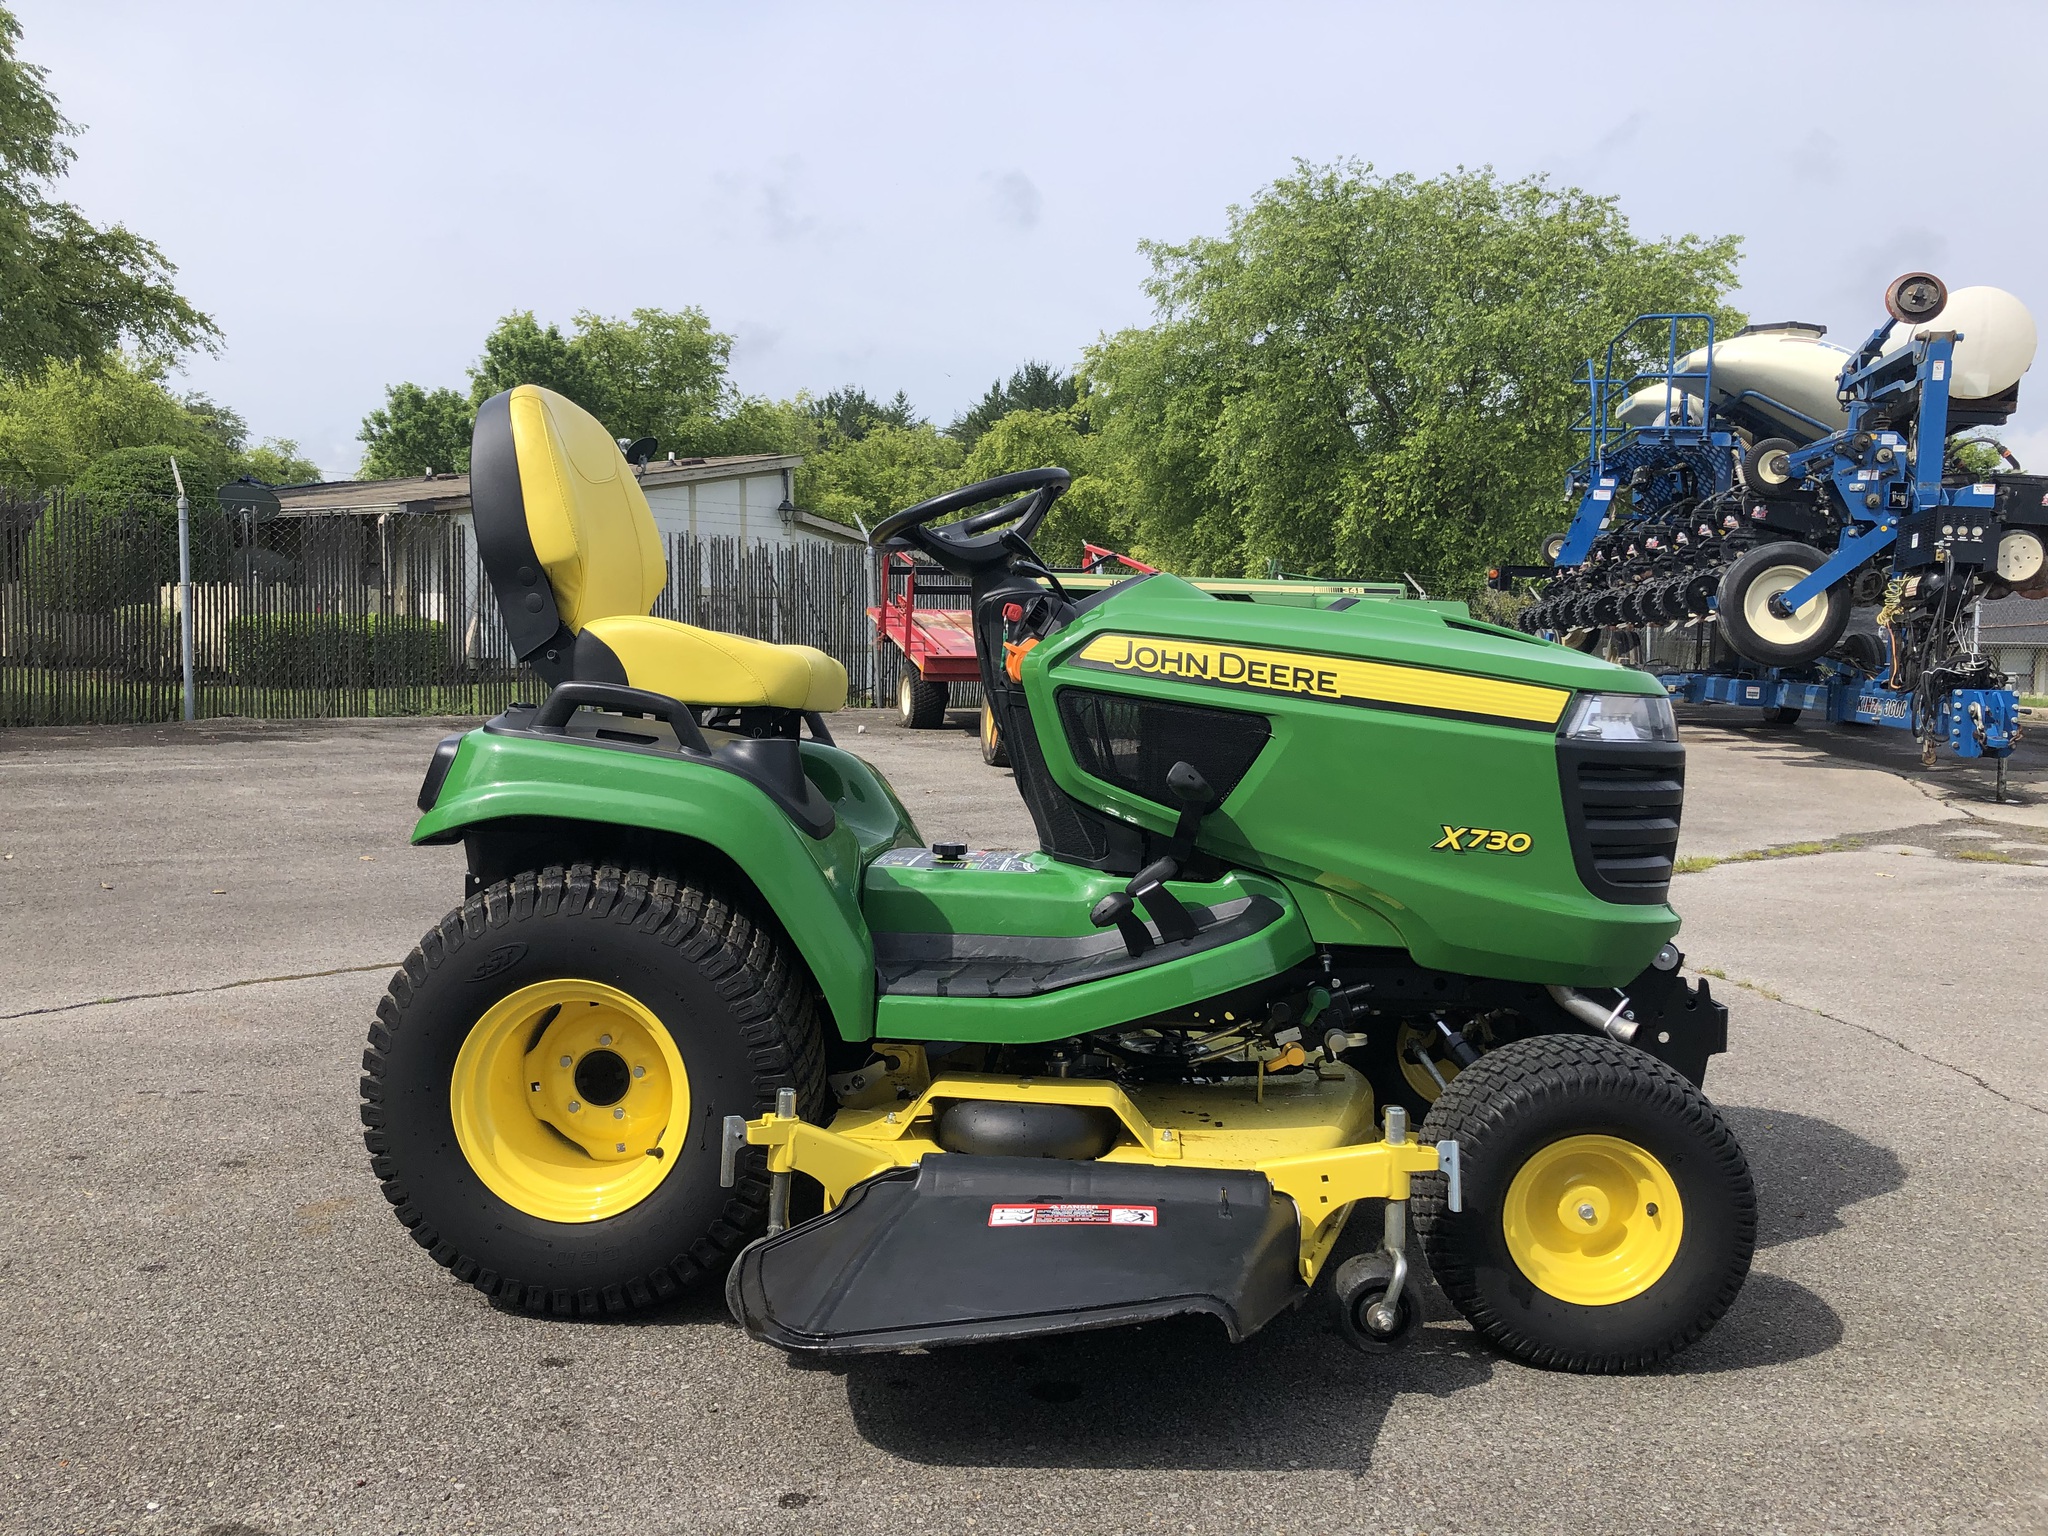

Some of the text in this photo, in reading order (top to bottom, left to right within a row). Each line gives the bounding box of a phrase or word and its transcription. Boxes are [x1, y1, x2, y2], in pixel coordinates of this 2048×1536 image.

[1114, 640, 1338, 694] JOHN DEERE
[1883, 698, 1908, 719] 3600
[1431, 825, 1533, 853] X730
